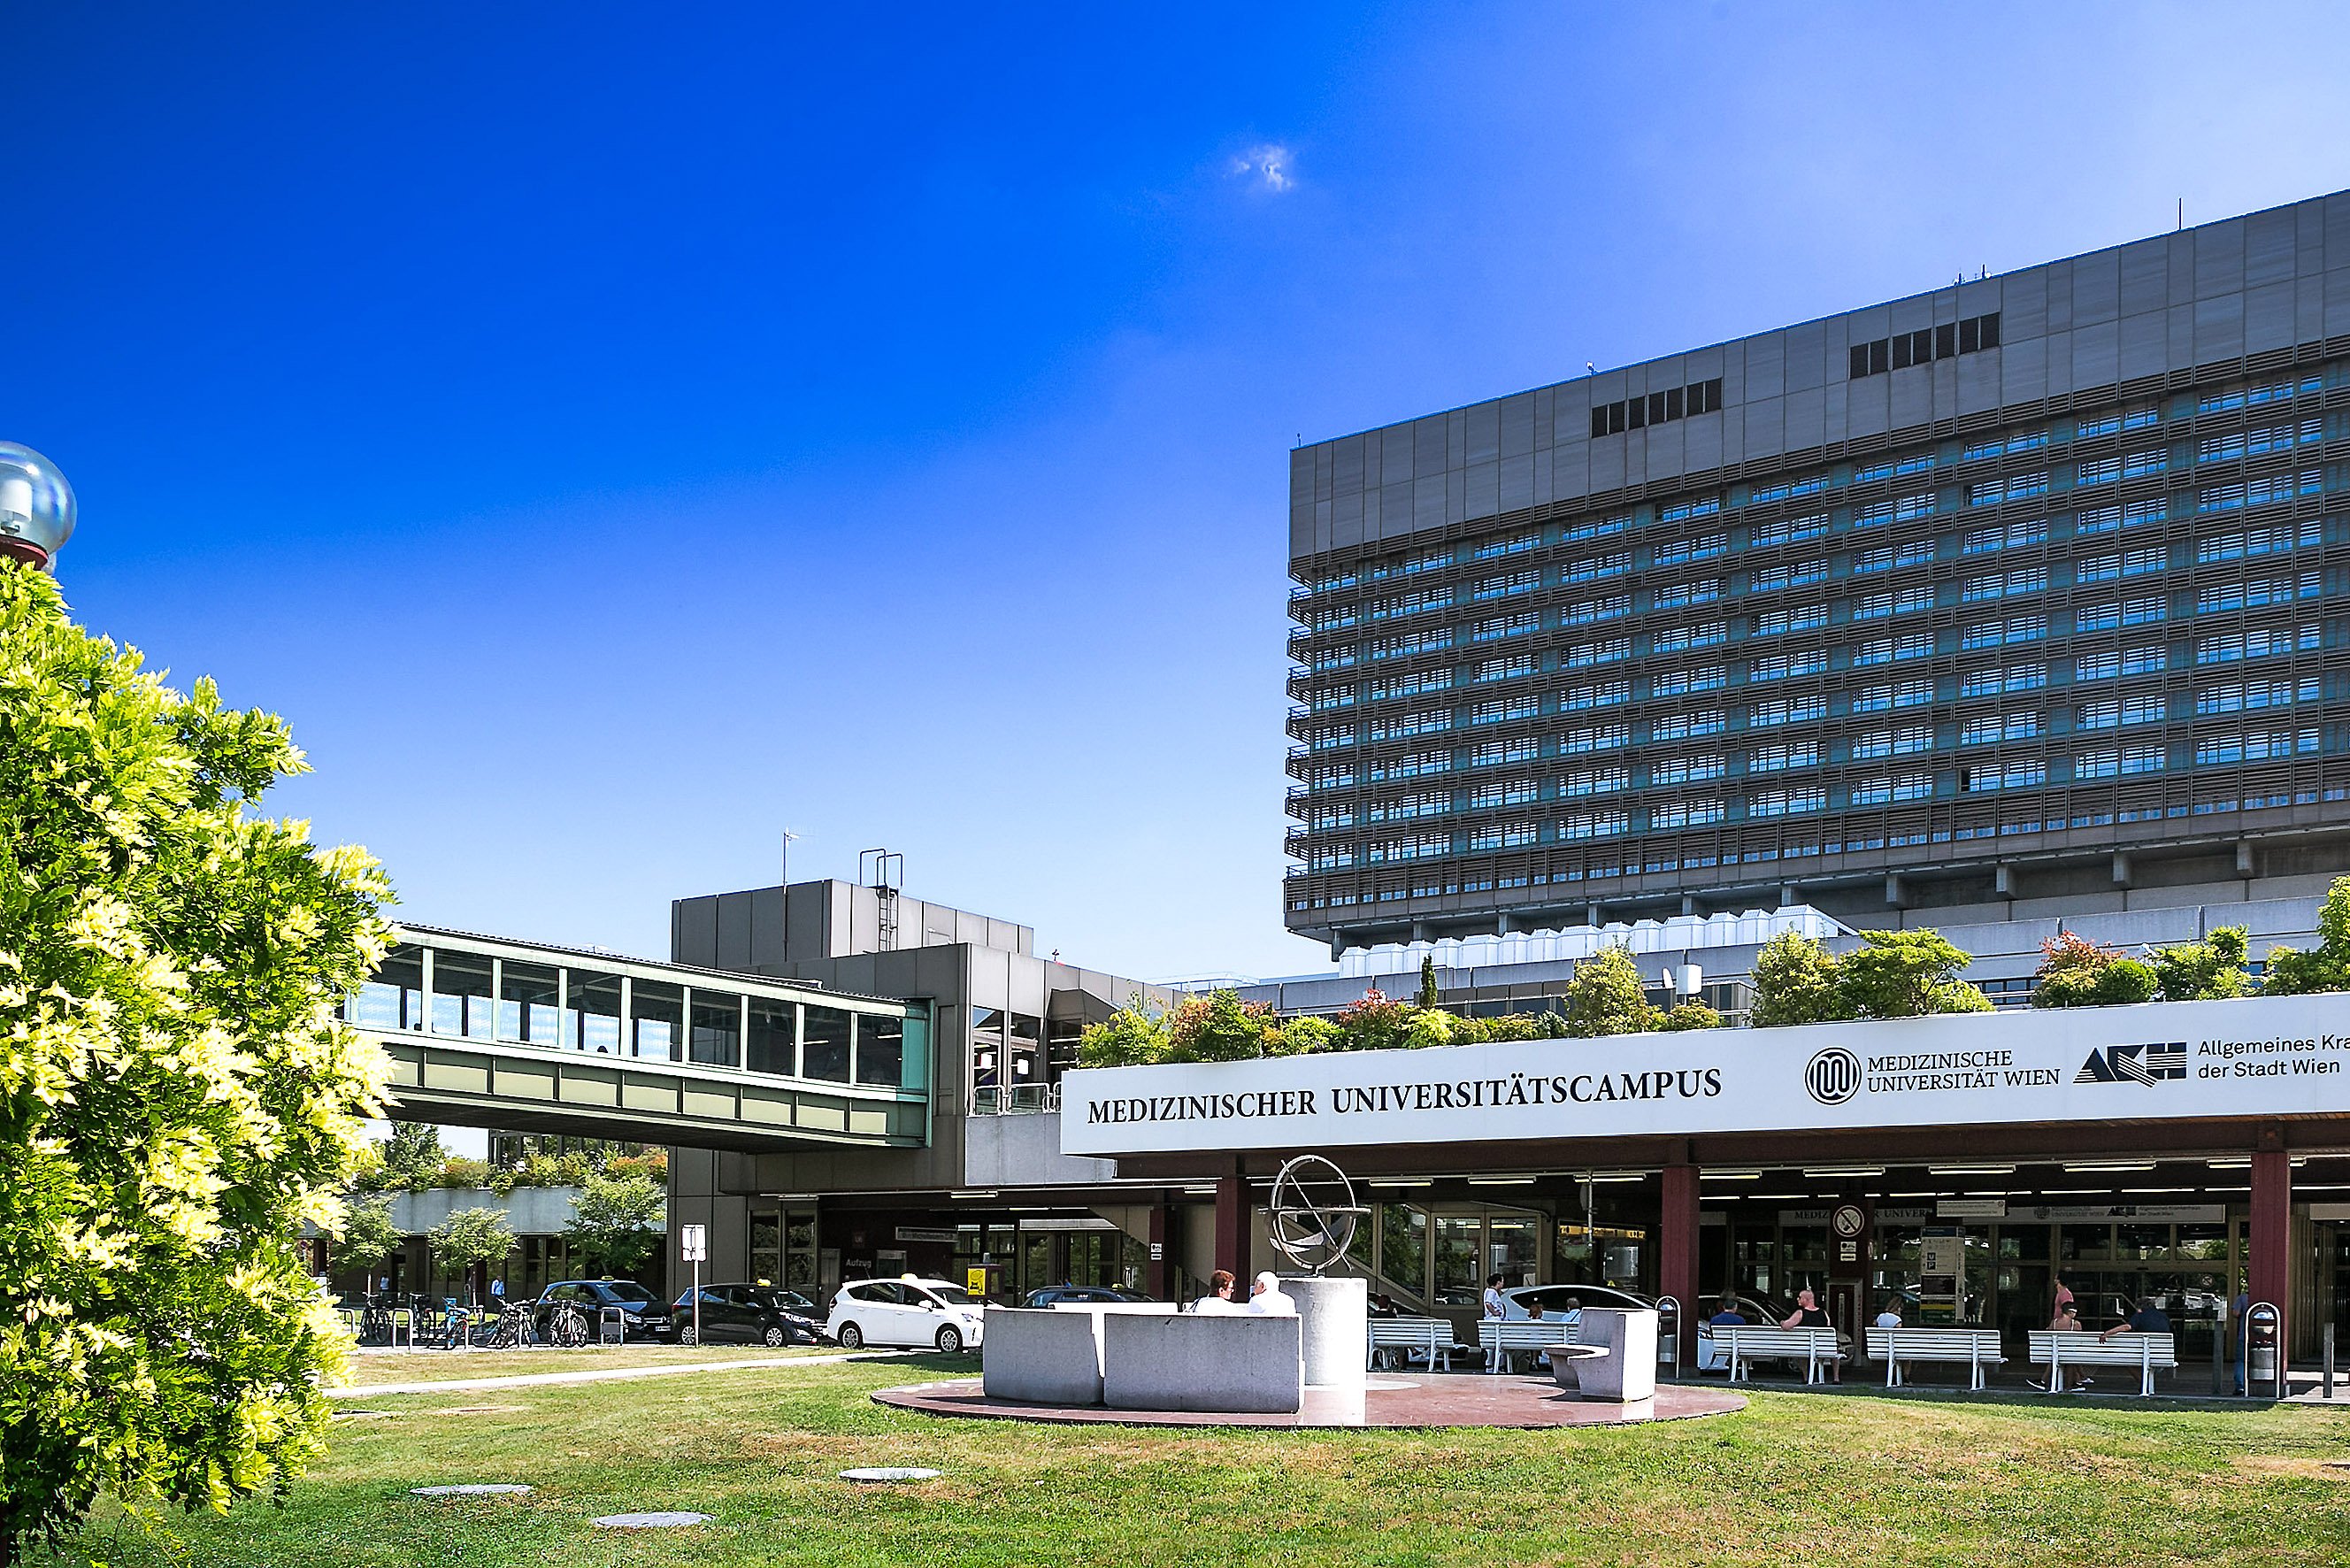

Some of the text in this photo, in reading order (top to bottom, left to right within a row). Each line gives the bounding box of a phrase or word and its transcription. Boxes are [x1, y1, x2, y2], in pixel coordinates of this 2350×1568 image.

[2198, 1034, 2350, 1059] Allgemeines Kra
[1868, 1050, 2013, 1072] MEDIZINISCHE
[2073, 1041, 2187, 1088] AKH
[2198, 1057, 2340, 1079] der Stadt Wien
[1868, 1068, 2061, 1093] UNIVERSITÄT WIEN
[1087, 1068, 1722, 1124] MEDIZINISCHER UNIVERSITÄTSCAMPUS
[1794, 1211, 1828, 1219] MEDIZ
[846, 1258, 872, 1269] Aufzug
